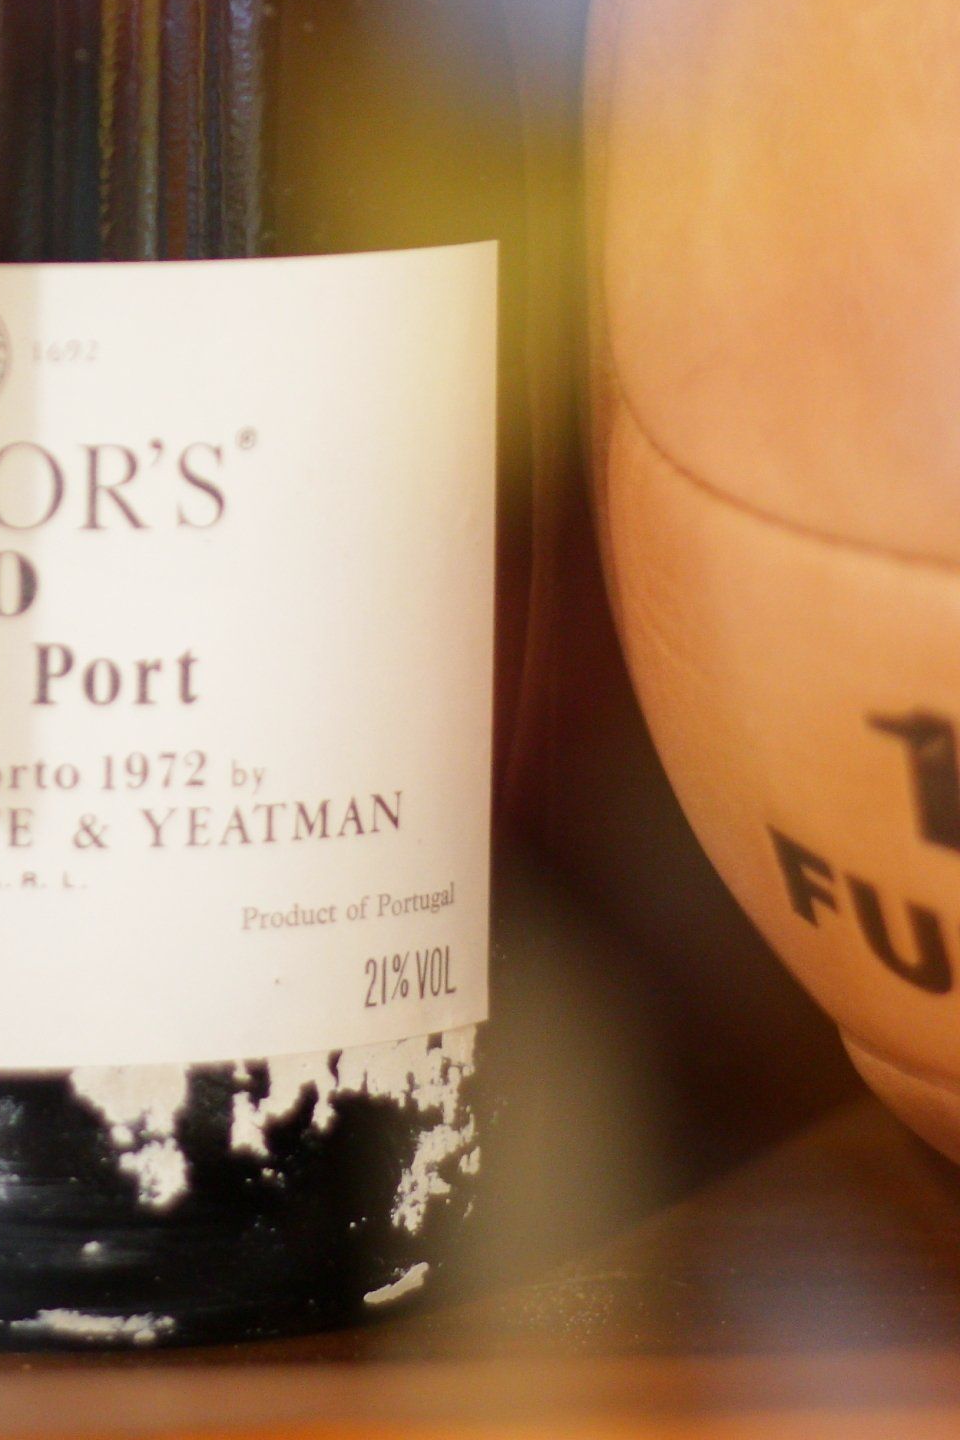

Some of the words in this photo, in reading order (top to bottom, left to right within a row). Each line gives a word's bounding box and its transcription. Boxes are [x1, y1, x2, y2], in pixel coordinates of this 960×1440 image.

[32, 642, 200, 708] Port
[100, 748, 209, 792] 1972
[230, 757, 267, 795] by
[72, 813, 108, 851] &
[140, 790, 403, 850] YEATMAN
[240, 900, 338, 933] Product
[345, 893, 372, 923] of
[376, 879, 457, 920] Portugal
[766, 822, 960, 996] FU
[363, 950, 411, 1010] 21%
[414, 944, 458, 1001] VOL
